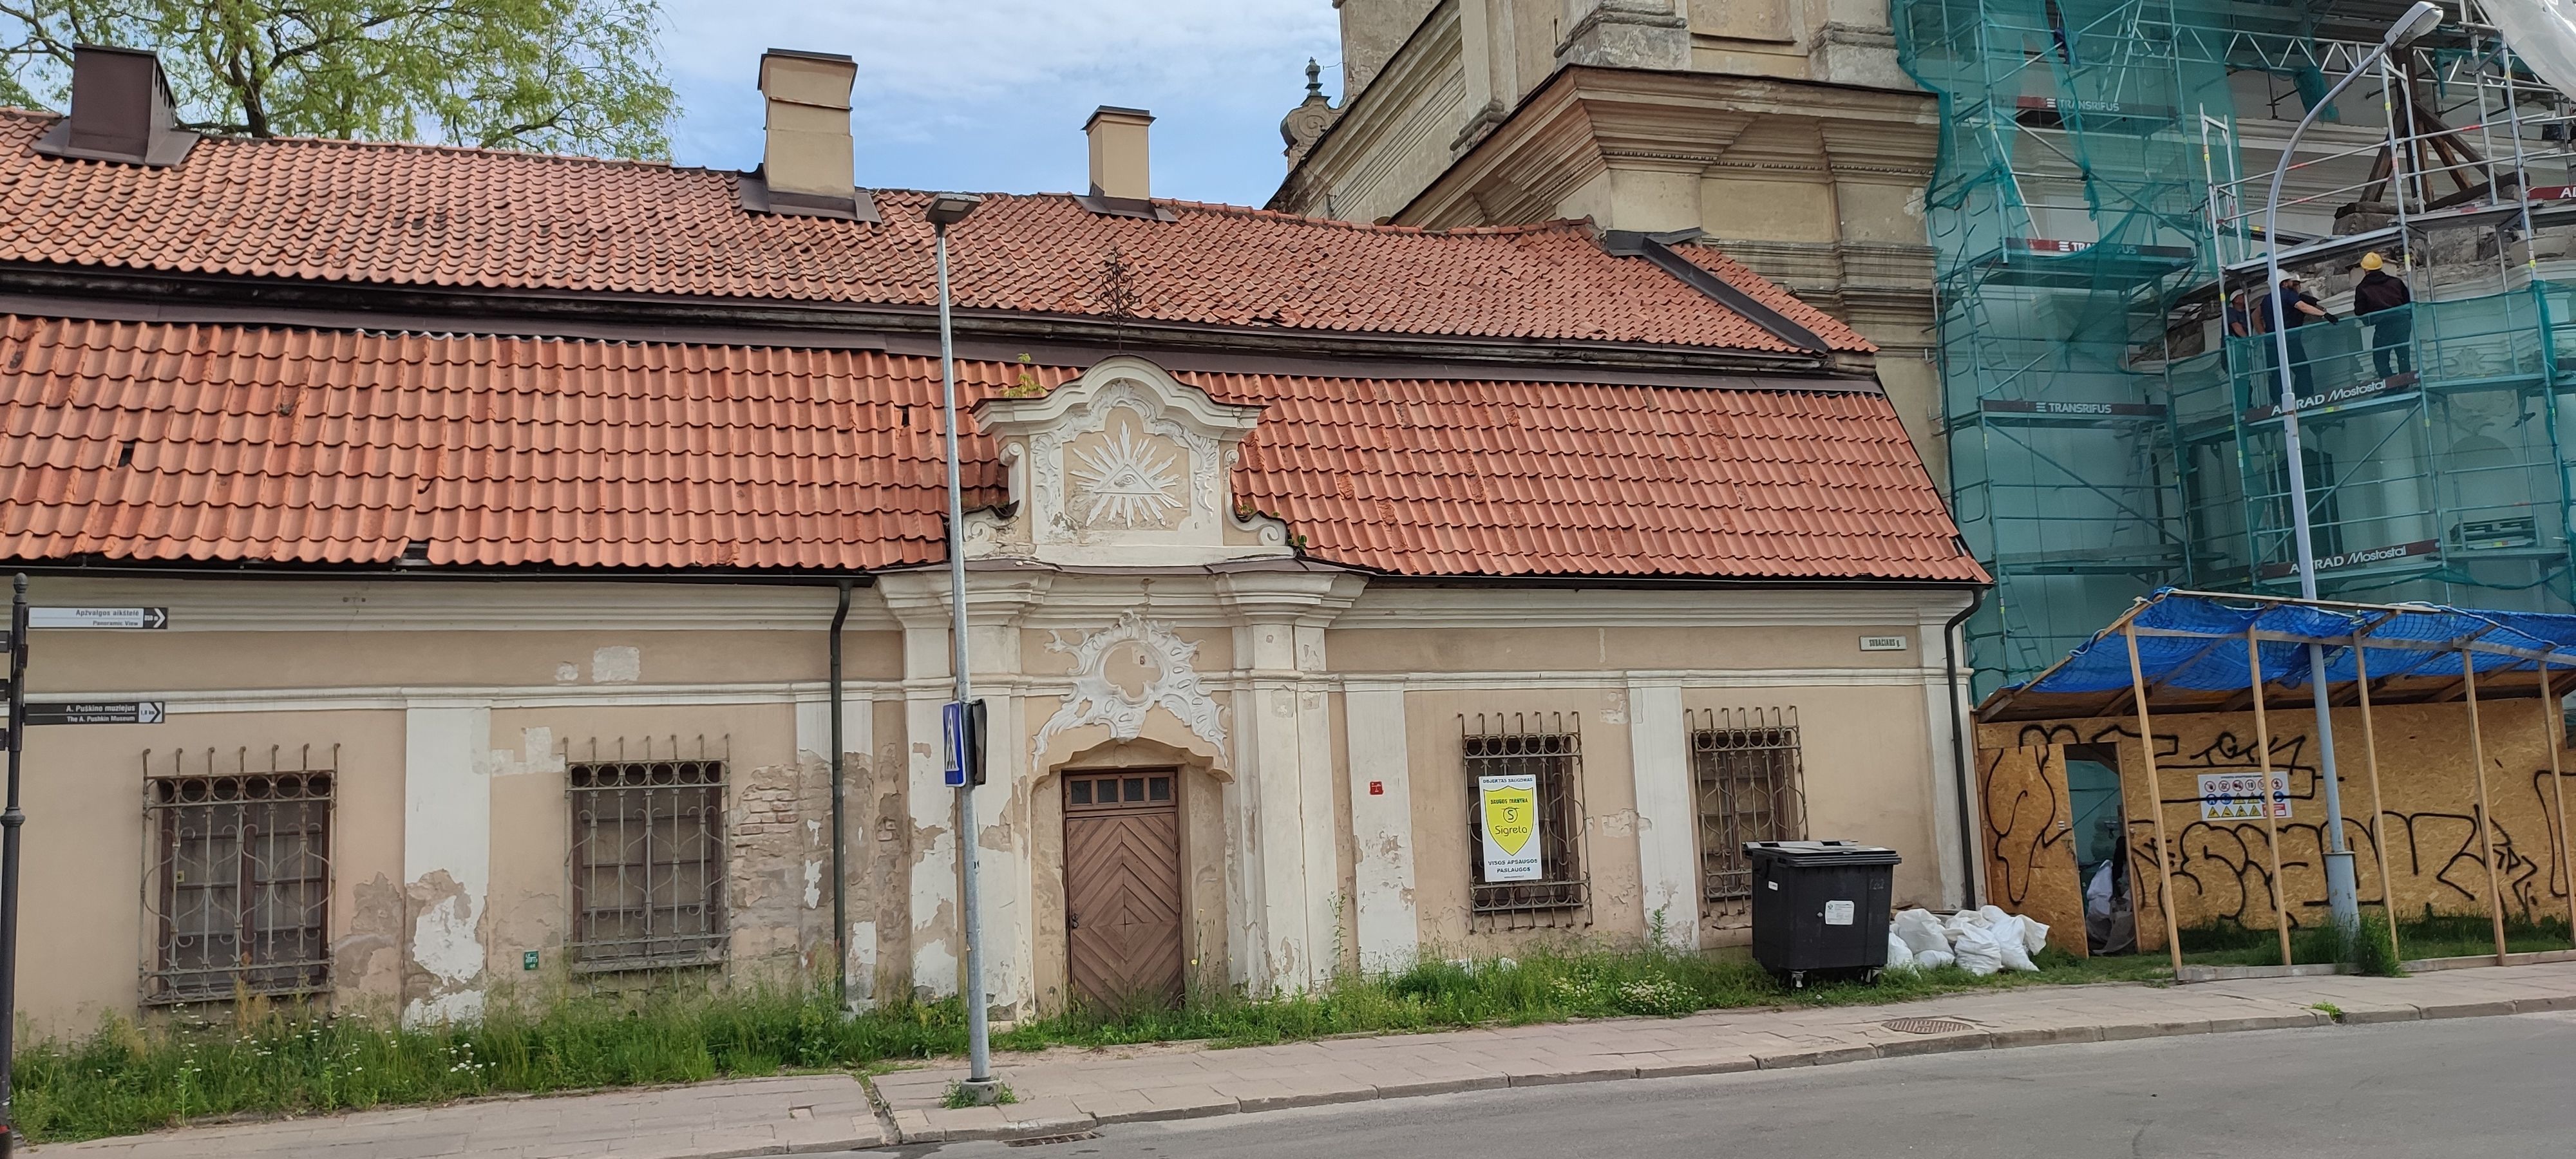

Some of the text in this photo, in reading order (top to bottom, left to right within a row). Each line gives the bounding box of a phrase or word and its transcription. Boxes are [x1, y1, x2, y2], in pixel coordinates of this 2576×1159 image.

[2060, 99, 2120, 112] TRANSRIFUS
[2271, 379, 2387, 416] ARAD Mostostal
[2048, 402, 2112, 414] TRANSRIFUS
[2289, 545, 2407, 574] ARAD Mostostal
[75, 704, 102, 712] Puškino
[105, 704, 135, 713] muziejus
